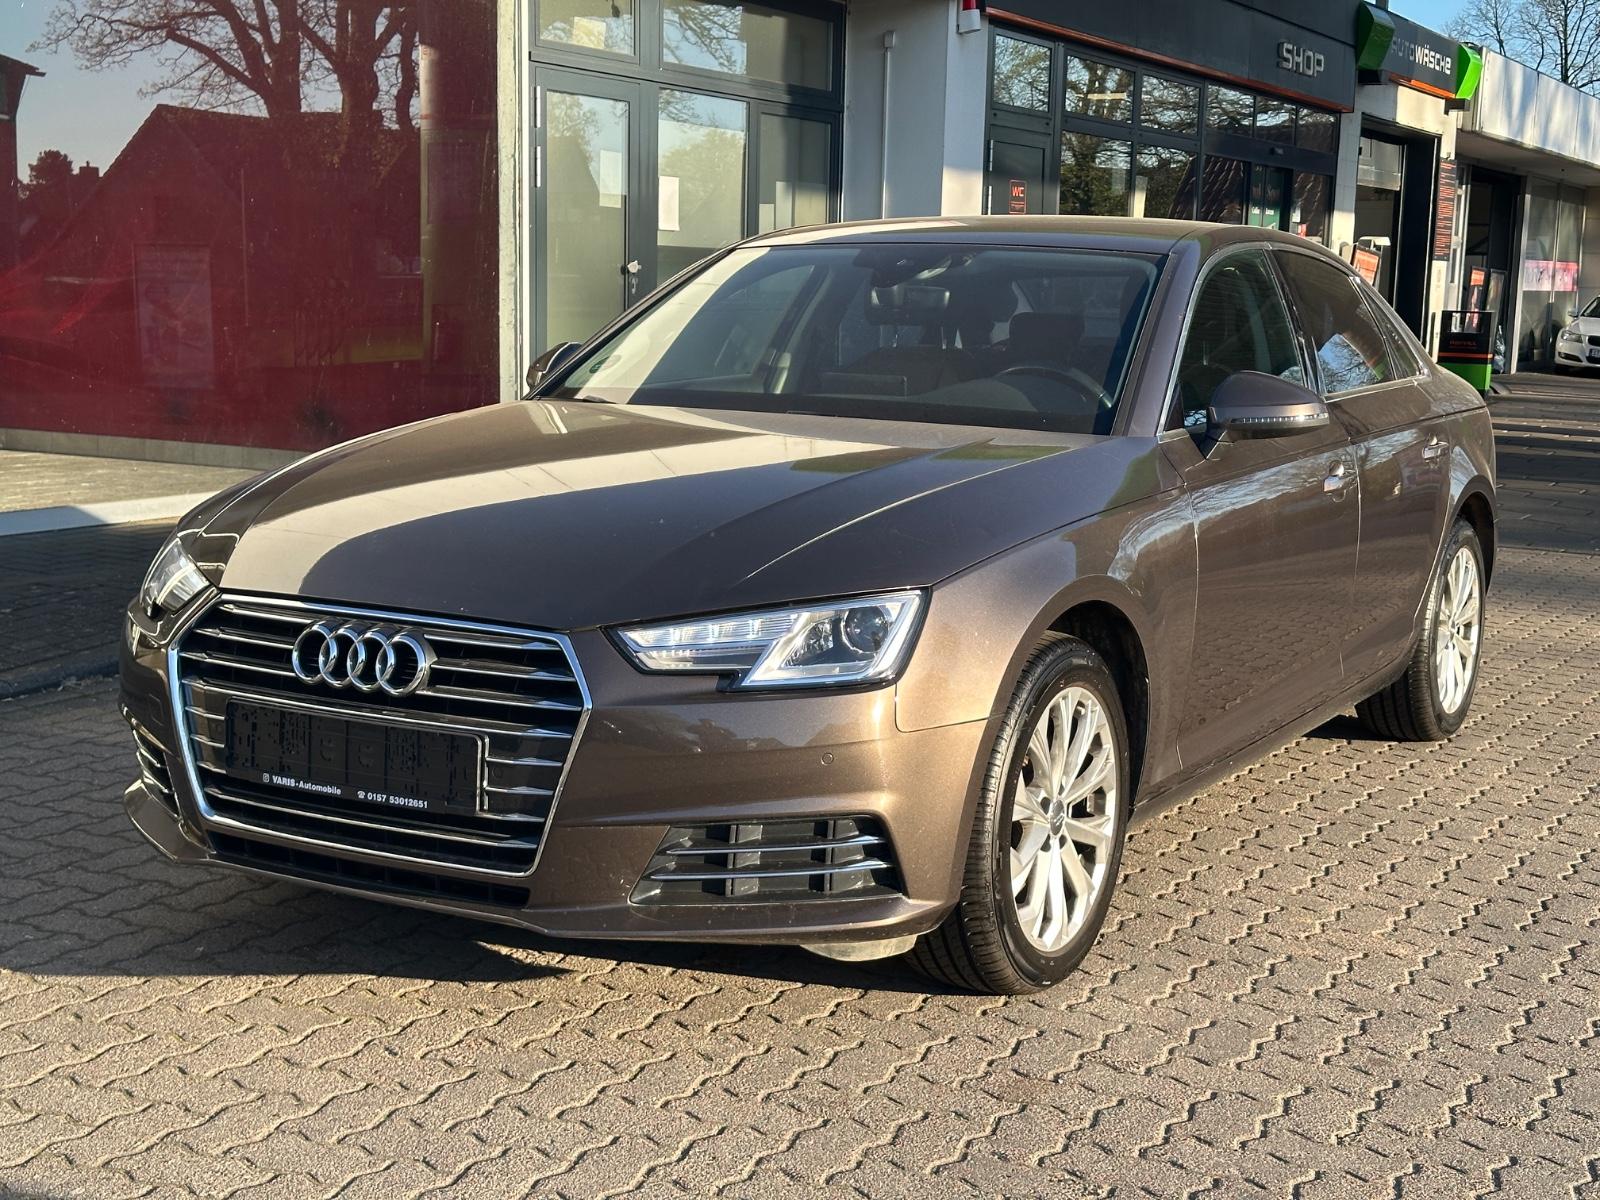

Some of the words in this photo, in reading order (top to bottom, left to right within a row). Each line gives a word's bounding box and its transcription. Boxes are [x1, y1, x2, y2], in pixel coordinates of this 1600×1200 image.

[1280, 42, 1325, 77] SHOP
[1012, 186, 1025, 197] WC
[272, 775, 342, 795] VARIS-Automobile
[367, 792, 387, 803] 0157
